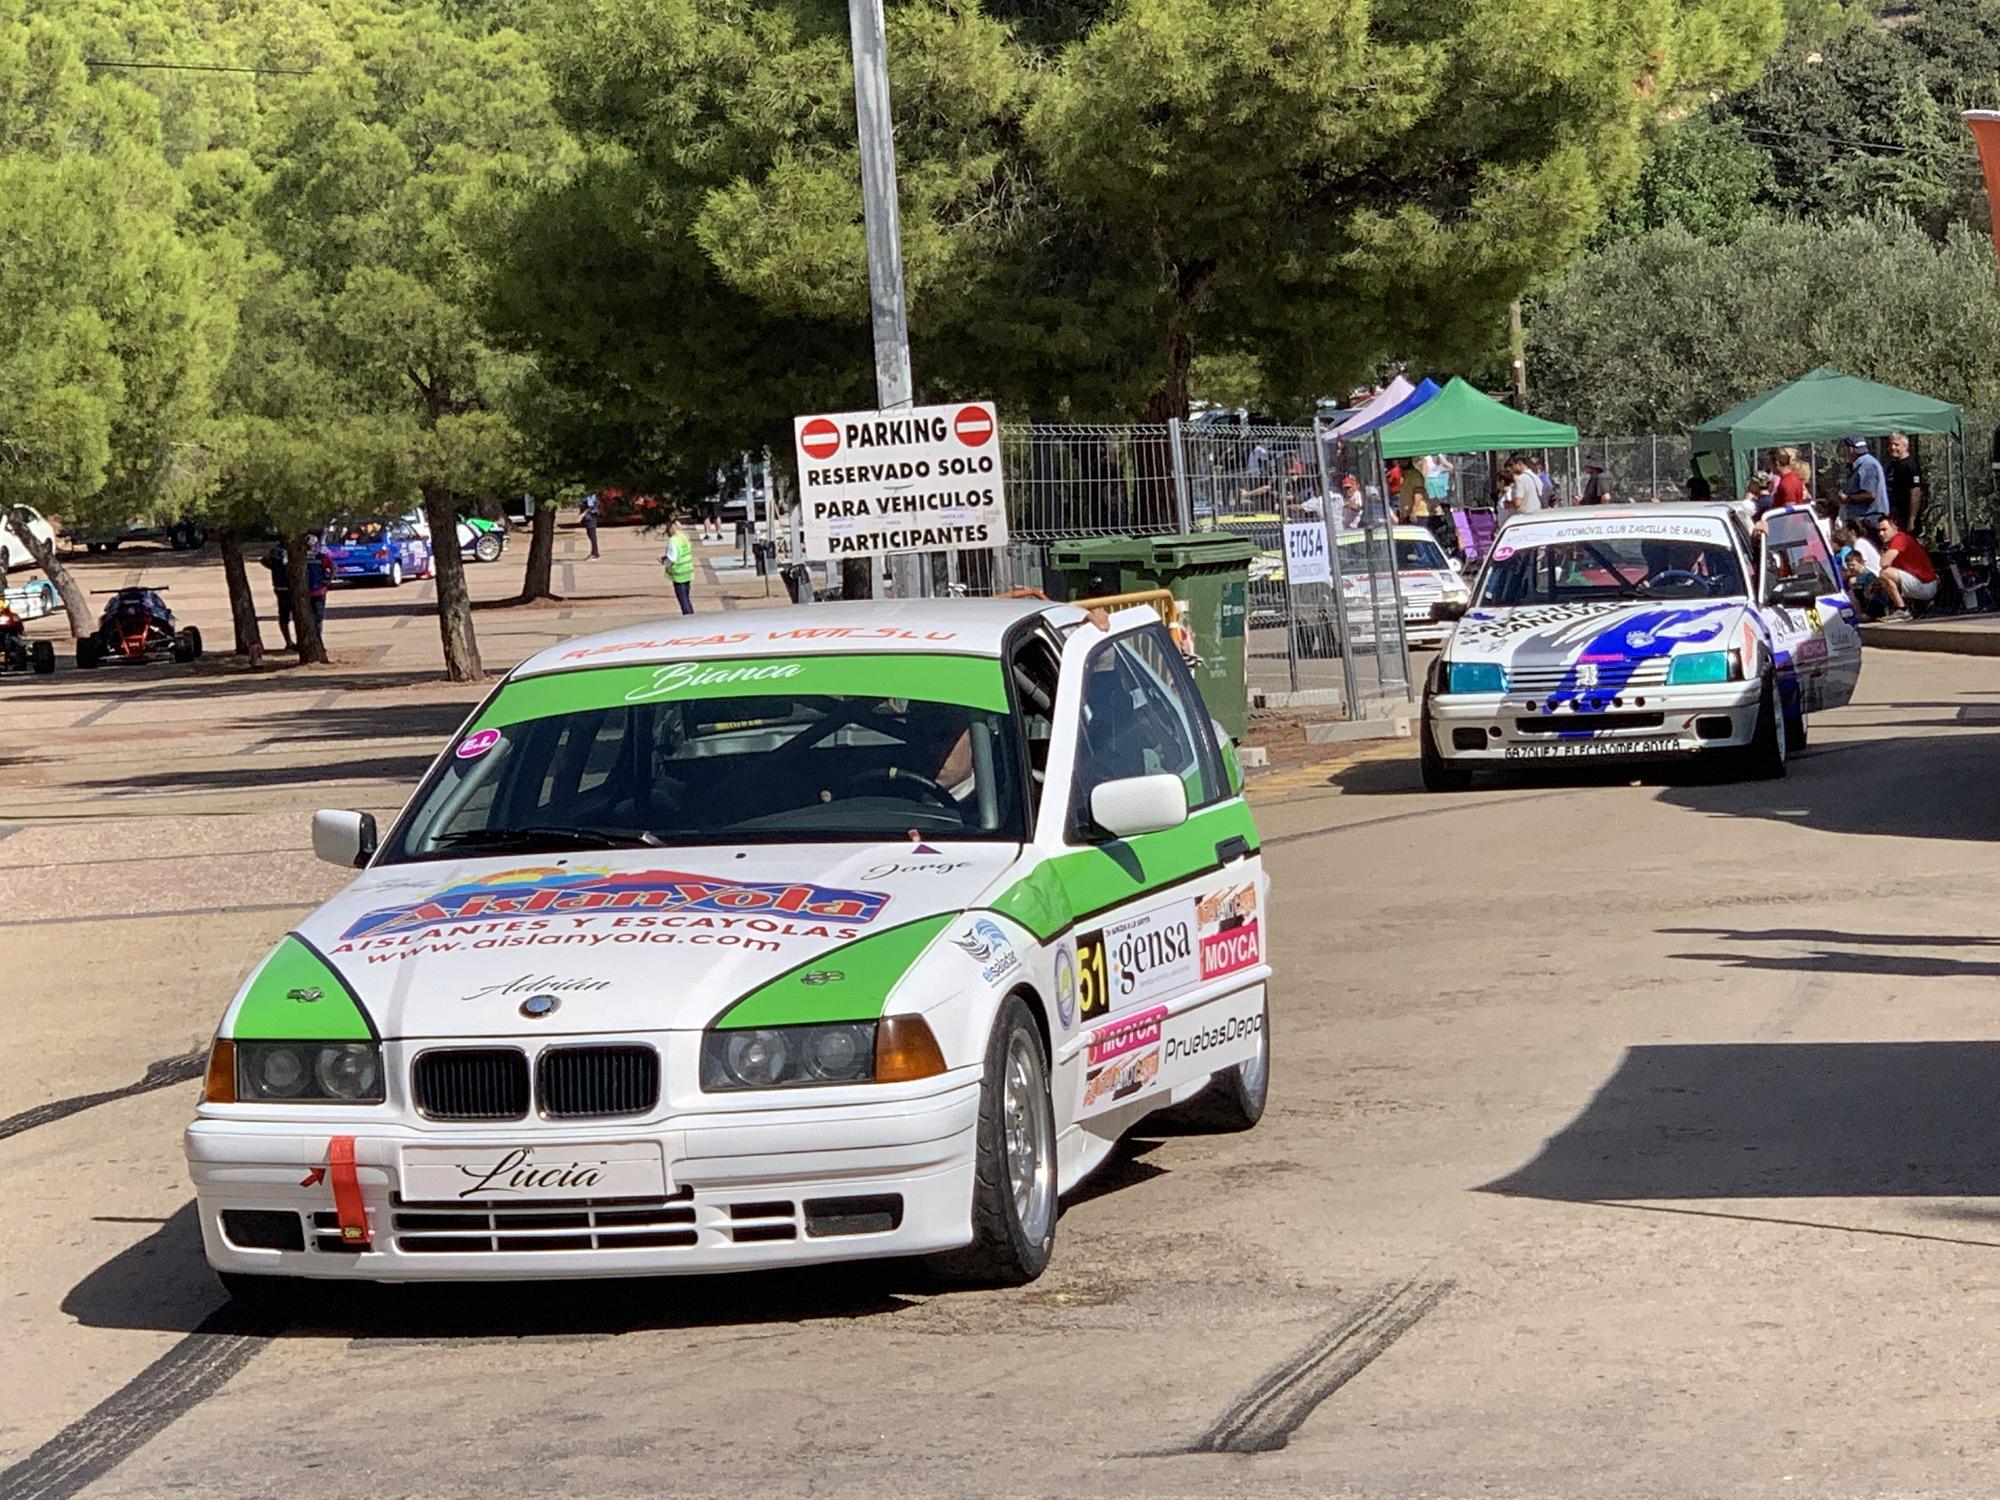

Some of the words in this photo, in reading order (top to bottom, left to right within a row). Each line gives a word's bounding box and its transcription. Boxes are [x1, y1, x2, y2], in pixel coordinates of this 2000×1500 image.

[846, 416, 947, 449] PARKING
[807, 460, 930, 486] RESERVADO
[938, 455, 993, 476] SOLO
[814, 499, 870, 519] PARA
[876, 488, 994, 514] VEHICULOS
[828, 524, 988, 553] PARTICIPANTES
[1289, 528, 1323, 558] ETOSA
[1606, 524, 1626, 534] CLUB
[1628, 524, 1667, 534] ZARCILLA
[1670, 525, 1681, 535] DE
[1683, 526, 1712, 538] RAMOS
[624, 662, 807, 701] Bianca
[860, 860, 974, 881] Jorge
[328, 917, 552, 955] AISLANTES
[572, 917, 598, 929] Y
[611, 916, 858, 940] ESCAYOLAS
[367, 931, 781, 964] www.aislanyola.com
[1204, 931, 1258, 973] MOYCA
[1118, 921, 1191, 995] gensa
[1076, 941, 1105, 1012] 51
